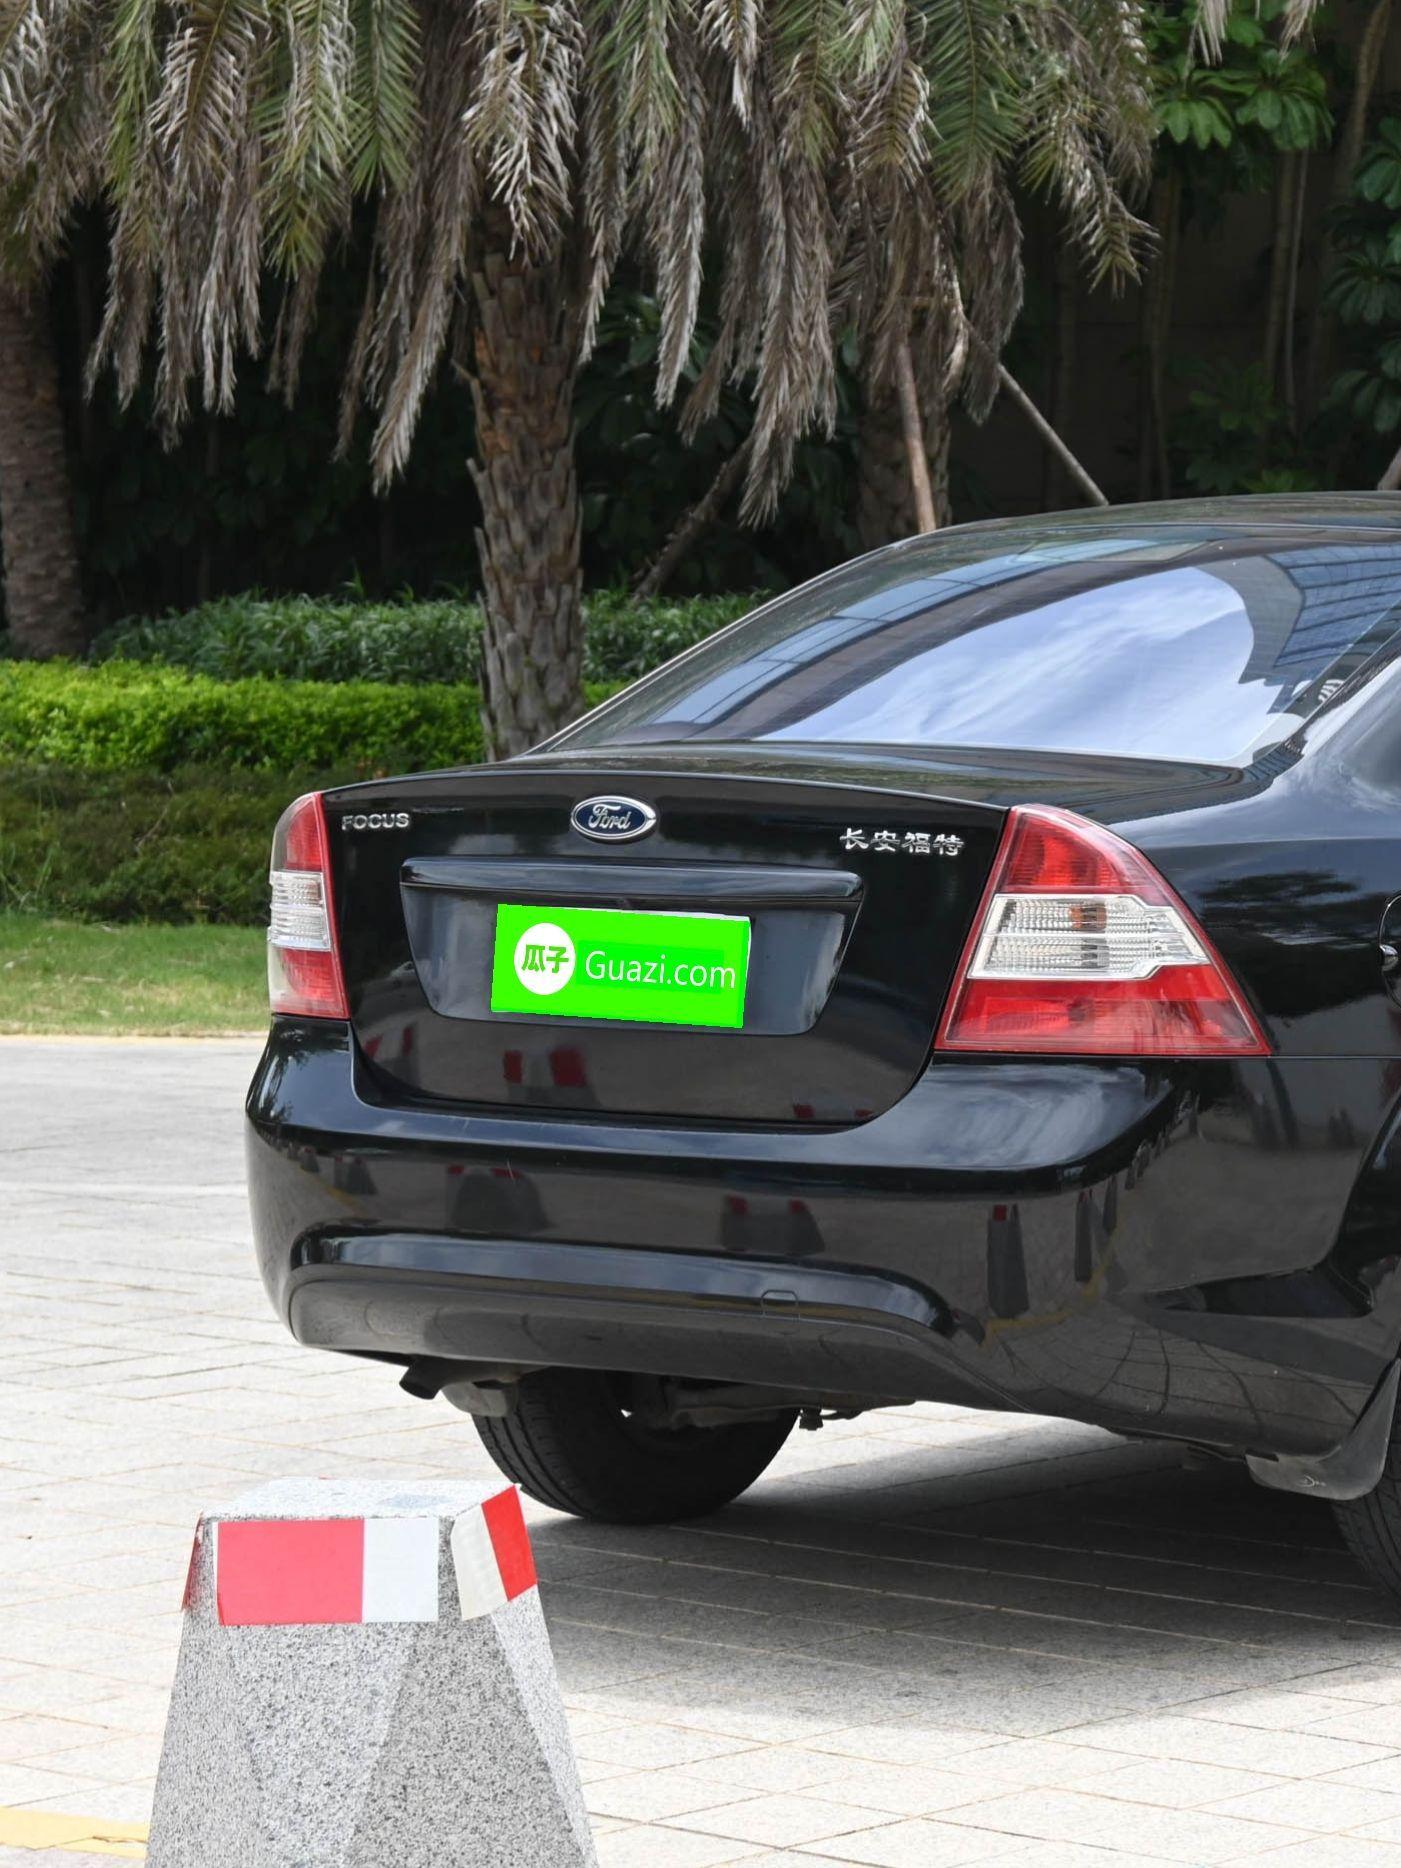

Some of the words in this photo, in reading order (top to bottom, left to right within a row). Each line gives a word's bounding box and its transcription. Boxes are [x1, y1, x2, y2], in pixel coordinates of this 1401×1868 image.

[342, 812, 410, 830] FOCUS
[588, 803, 632, 831] Ford
[839, 827, 965, 856] 长安福特
